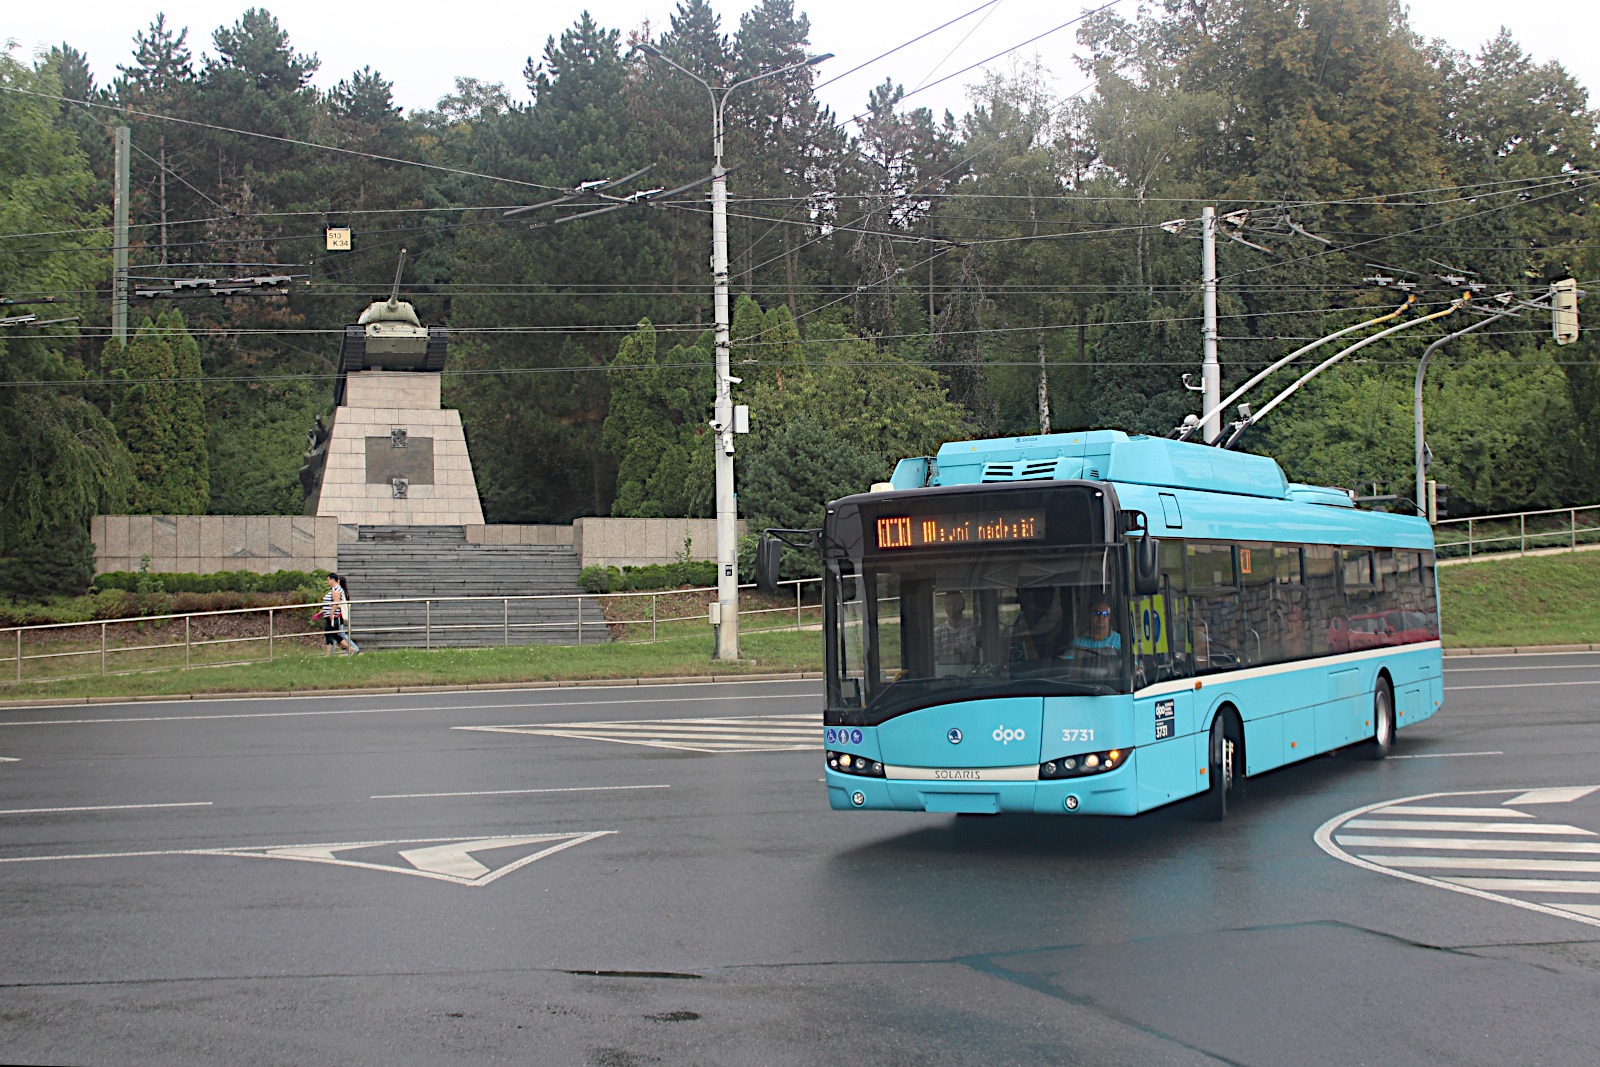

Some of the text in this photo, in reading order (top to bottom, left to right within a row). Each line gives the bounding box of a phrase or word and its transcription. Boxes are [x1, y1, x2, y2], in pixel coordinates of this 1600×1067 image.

[992, 725, 1026, 746] dpo
[1062, 729, 1095, 742] 3731
[1156, 725, 1168, 739] 3731
[935, 770, 981, 779] SOLARIS
